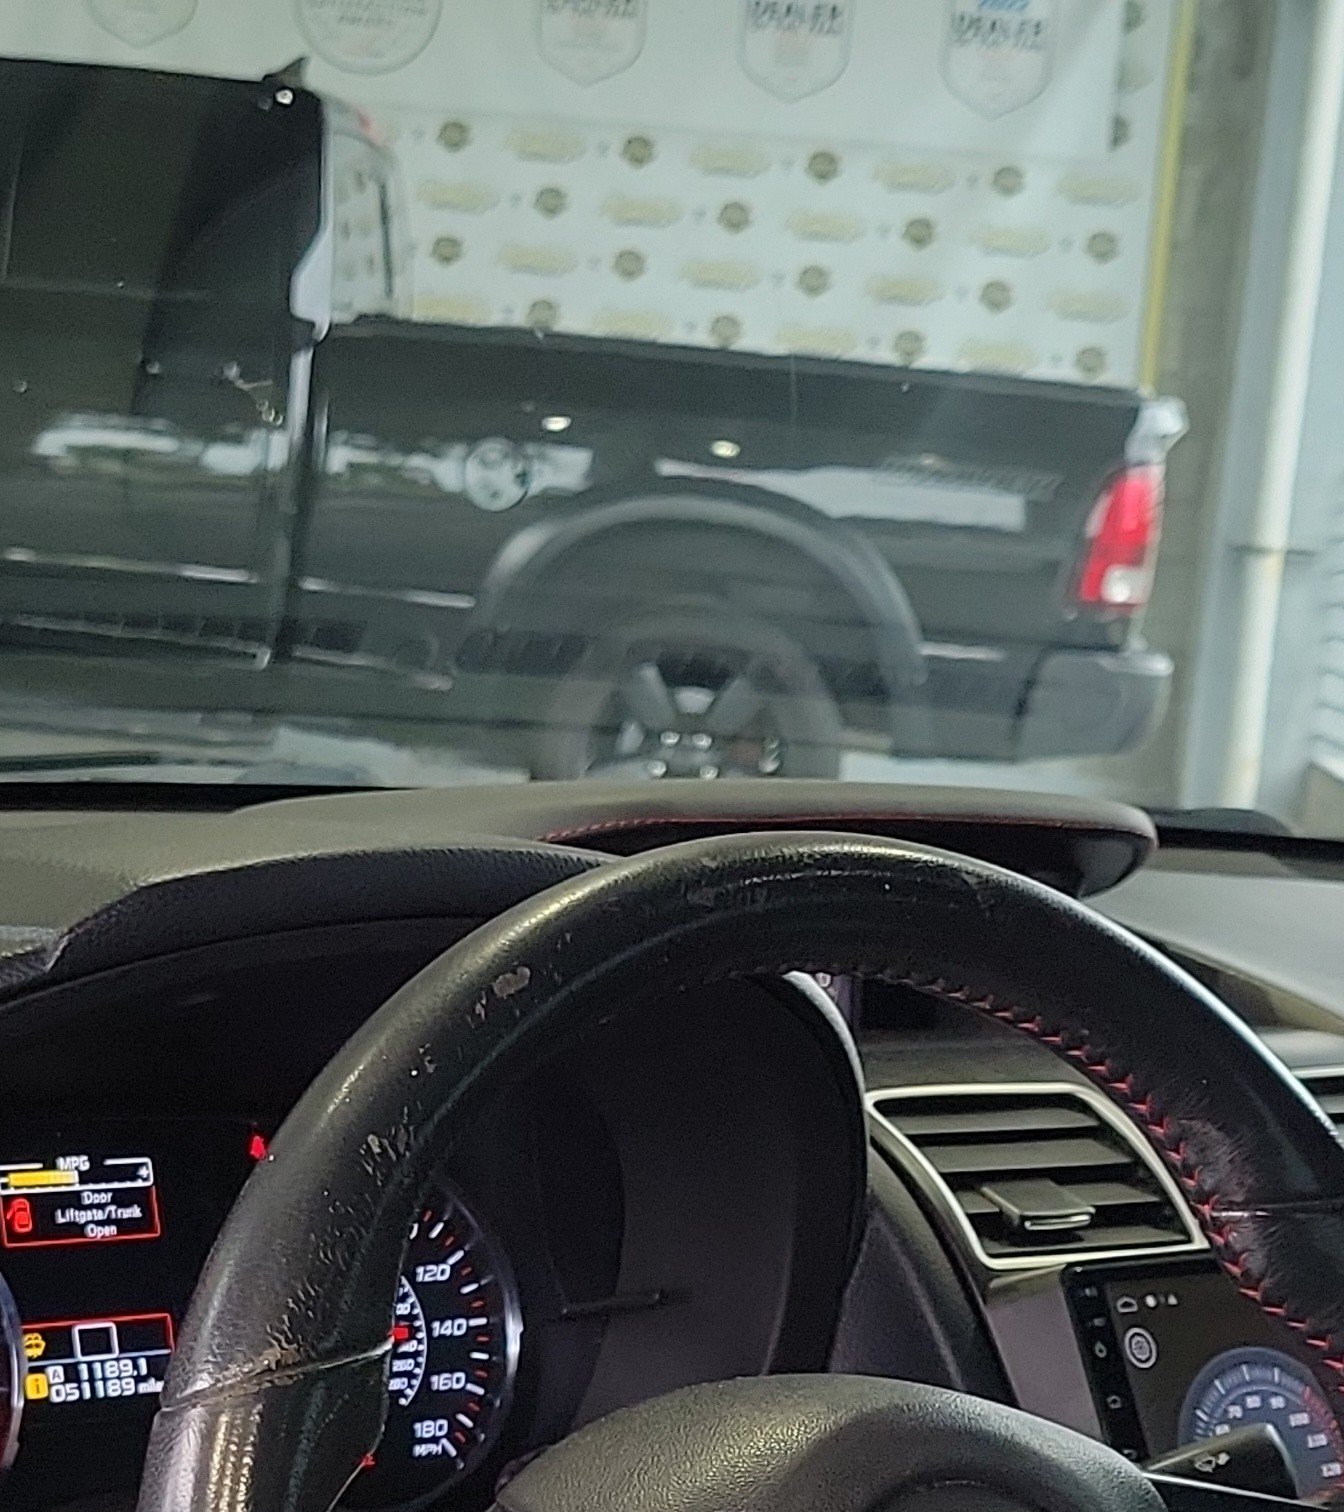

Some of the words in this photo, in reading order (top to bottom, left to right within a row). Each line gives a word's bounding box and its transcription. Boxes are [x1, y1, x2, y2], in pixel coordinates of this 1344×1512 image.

[56, 1155, 90, 1172] MPG
[80, 1191, 113, 1205] Door
[55, 1204, 143, 1224] Liftgate/Trunk
[84, 1223, 118, 1239] Open
[415, 1263, 451, 1283] 120
[430, 1317, 468, 1338] 140
[77, 1357, 148, 1381] 1189.1
[49, 1377, 136, 1403] 051189
[429, 1371, 467, 1391] 160
[412, 1418, 449, 1439] 180
[412, 1442, 443, 1458] MPH
